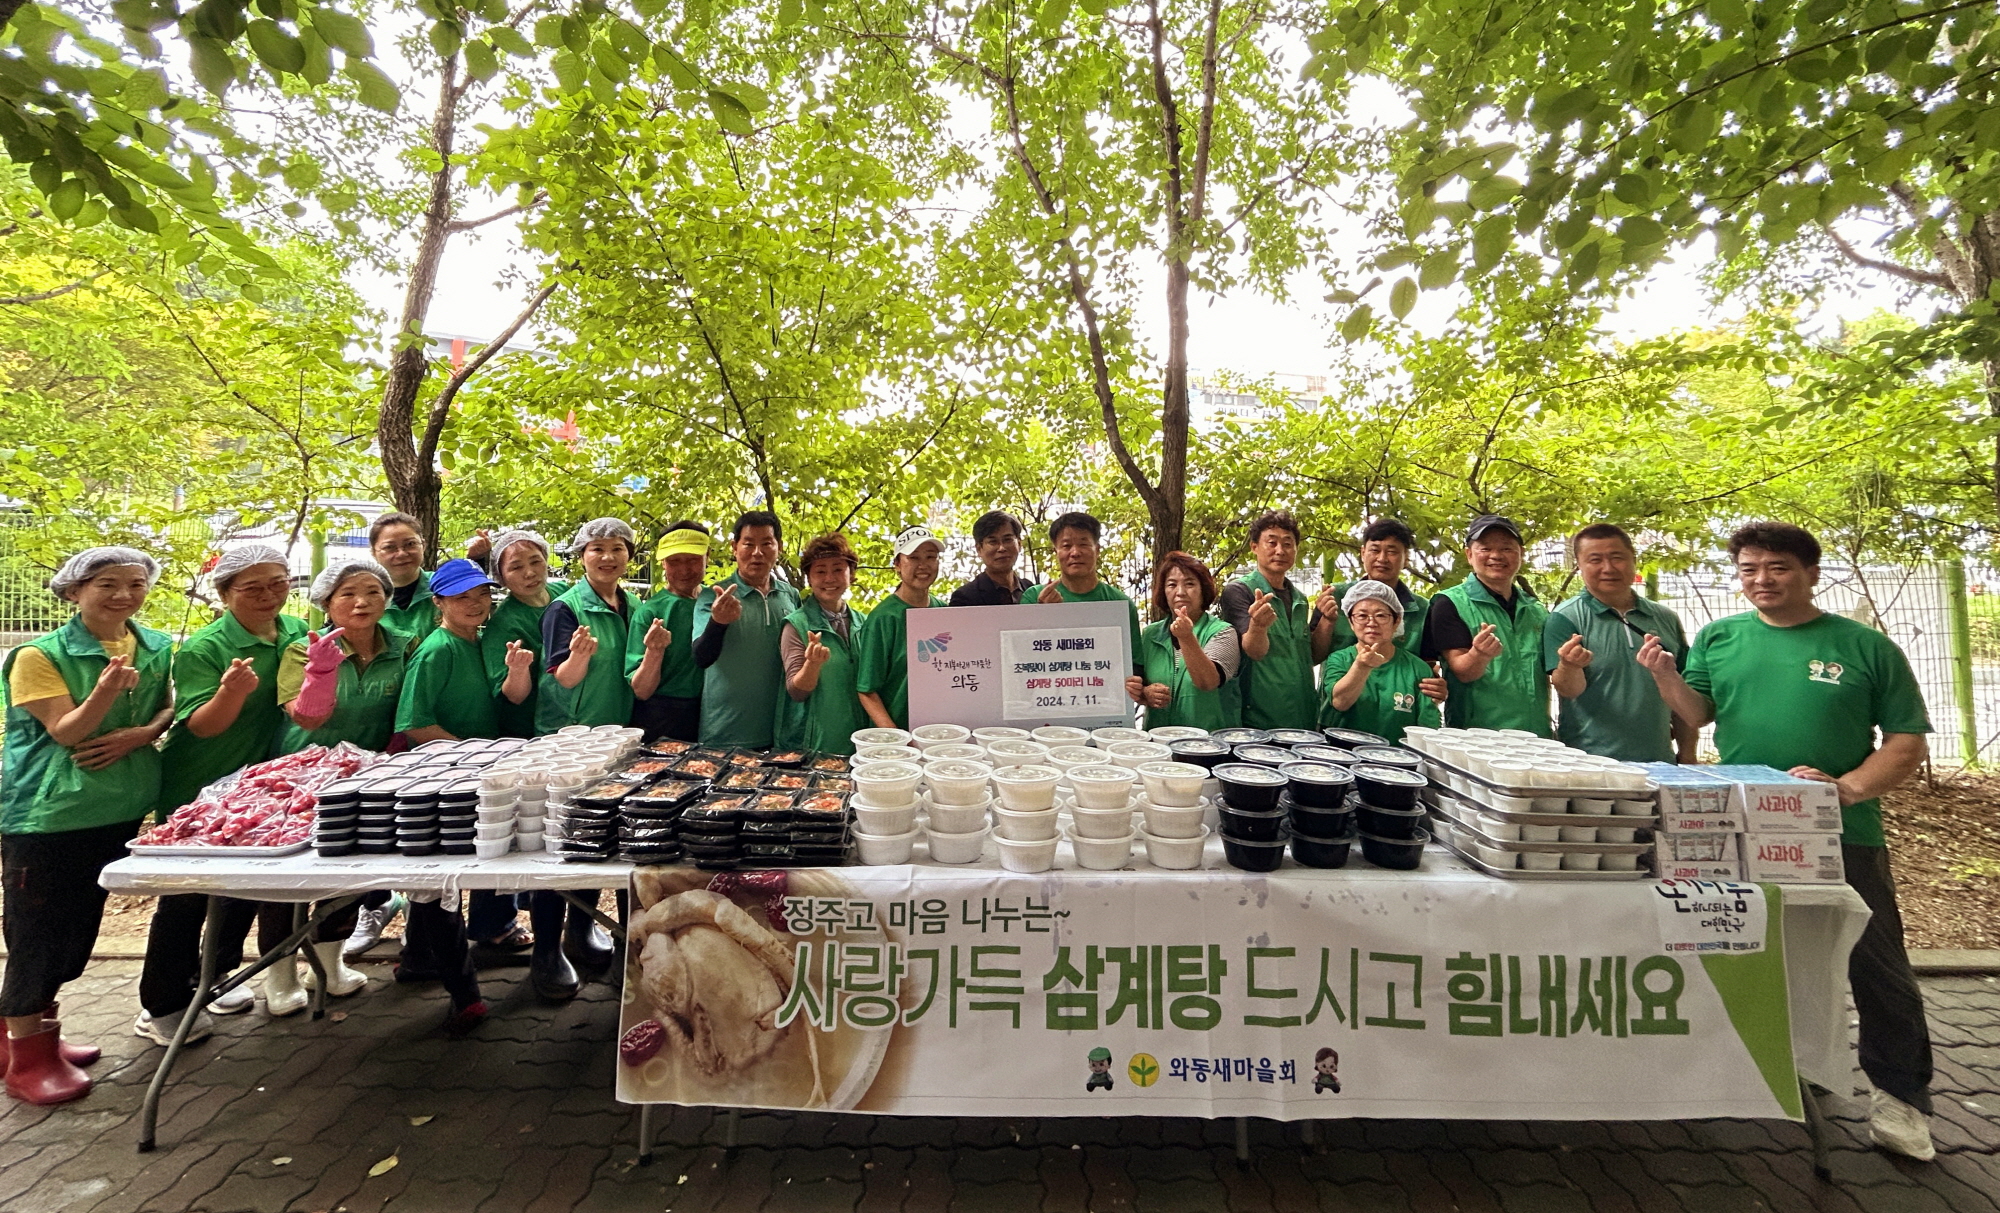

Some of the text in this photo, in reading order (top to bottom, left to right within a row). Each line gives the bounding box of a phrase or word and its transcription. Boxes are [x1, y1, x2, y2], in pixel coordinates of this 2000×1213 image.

[1032, 637, 1095, 652] 와동 새마을회
[931, 656, 943, 672] 한
[1014, 660, 1111, 673] 초복맞이 삼계탕 나눔 행사
[950, 674, 981, 692] 와동
[1026, 676, 1104, 689] 삼계탕 50마리 나눔
[1036, 694, 1101, 707] 2024. 7. 11.
[1756, 794, 1803, 813] 사과야
[1757, 843, 1805, 863] 사과야
[784, 897, 1071, 935] 정주고 마음 나누는~
[1691, 901, 1734, 917] 하나되는
[1701, 916, 1745, 933] 대한민국
[777, 941, 1691, 1039] 사랑가득 삼계탕 드시고 힘내세요
[1168, 1056, 1297, 1085] 와동새마을회
